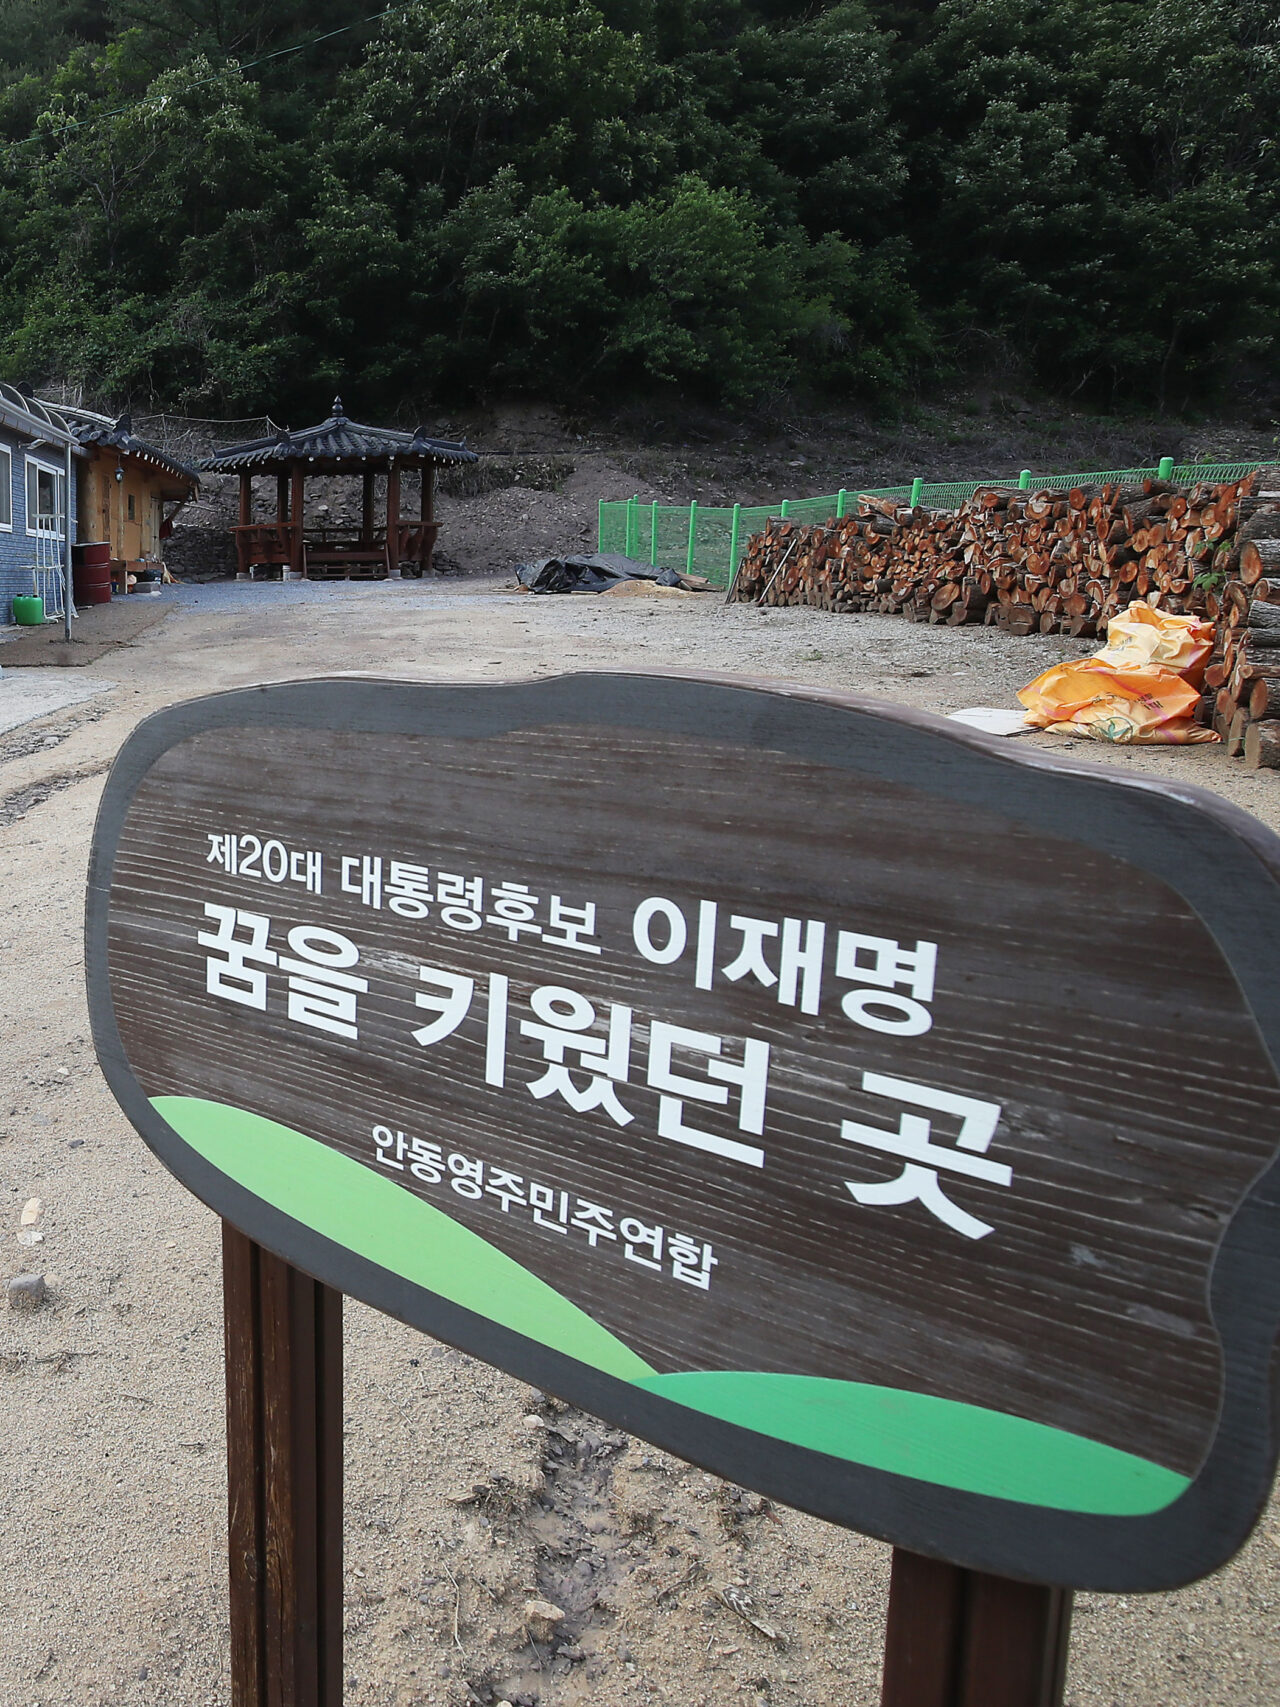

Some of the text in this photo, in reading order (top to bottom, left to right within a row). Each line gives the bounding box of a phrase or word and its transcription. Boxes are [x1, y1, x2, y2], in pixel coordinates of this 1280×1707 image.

[206, 833, 938, 1036] 제20대 대통령후보 이재명
[197, 901, 1012, 1240] 꿈을 키웠던 곳
[372, 1124, 719, 1291] 안동영주민주연합
